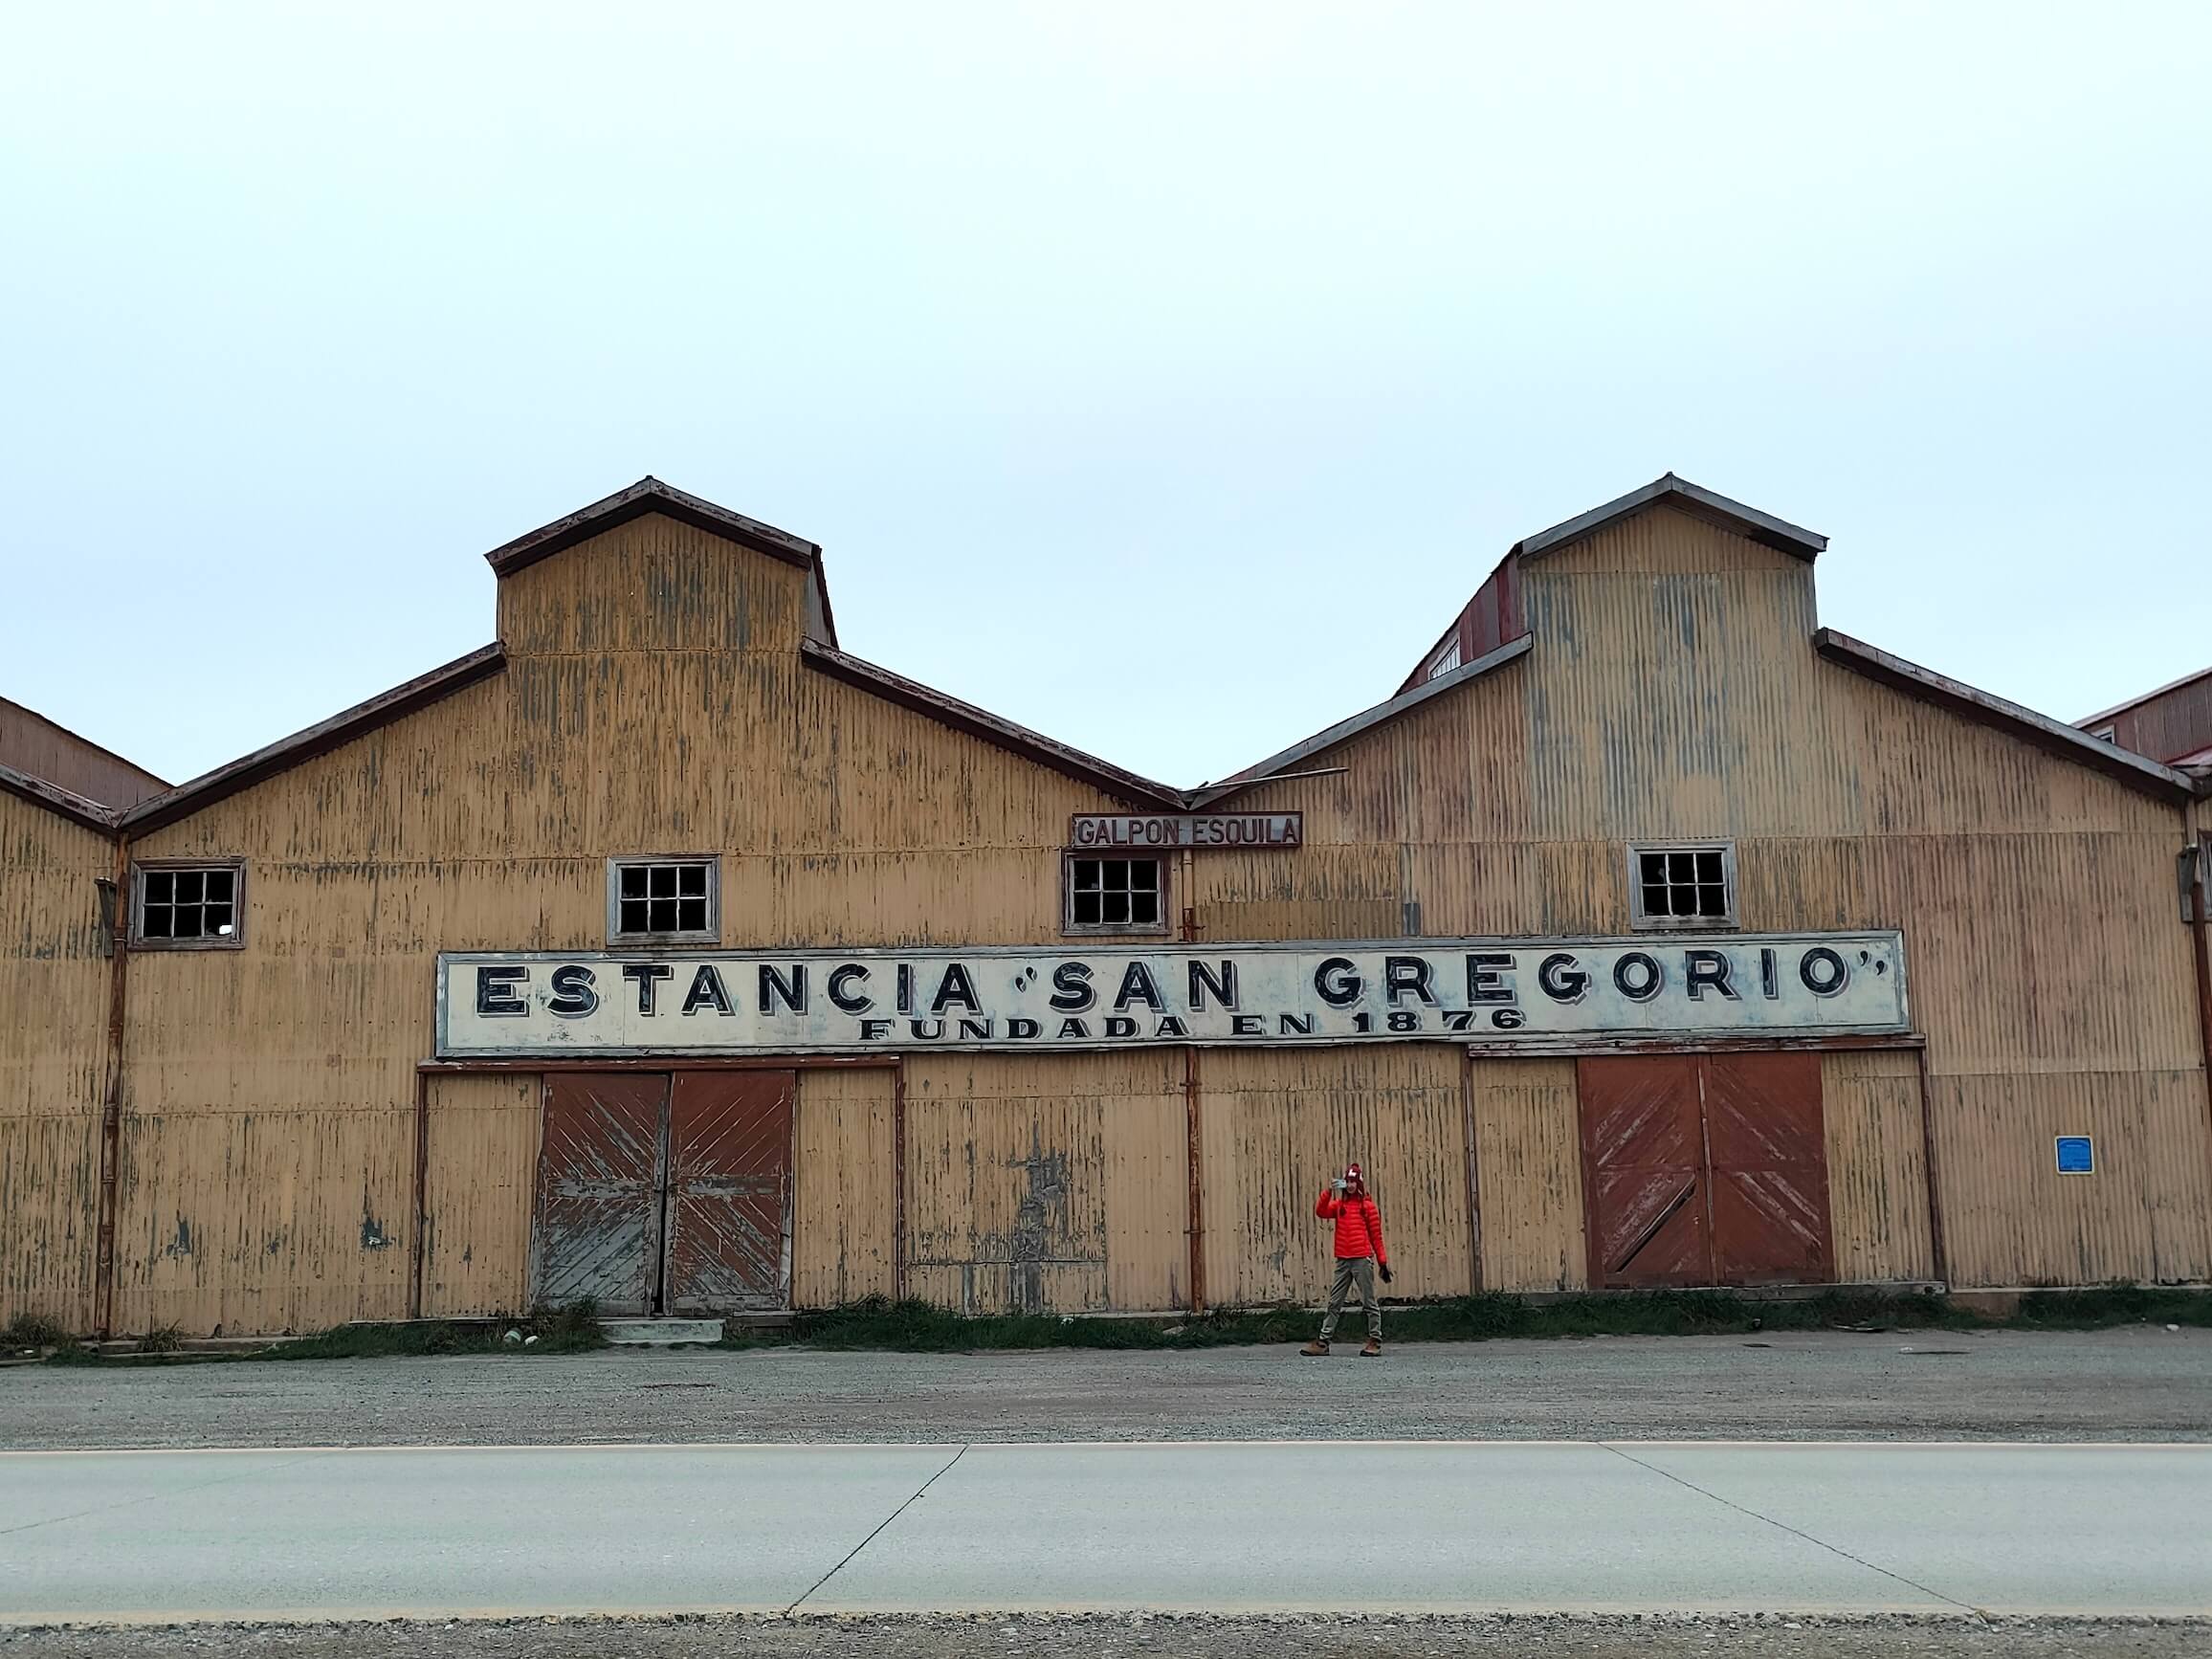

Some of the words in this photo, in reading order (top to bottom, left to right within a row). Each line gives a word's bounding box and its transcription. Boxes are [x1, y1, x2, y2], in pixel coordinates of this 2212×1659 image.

[1076, 820, 1180, 844] GALPON
[1193, 819, 1297, 844] ESQUILA
[476, 962, 984, 1018] ESTANCIA
[858, 1016, 1190, 1041] FUNDADA
[1230, 1013, 1316, 1035] EN
[1352, 1008, 1527, 1033] 1876
